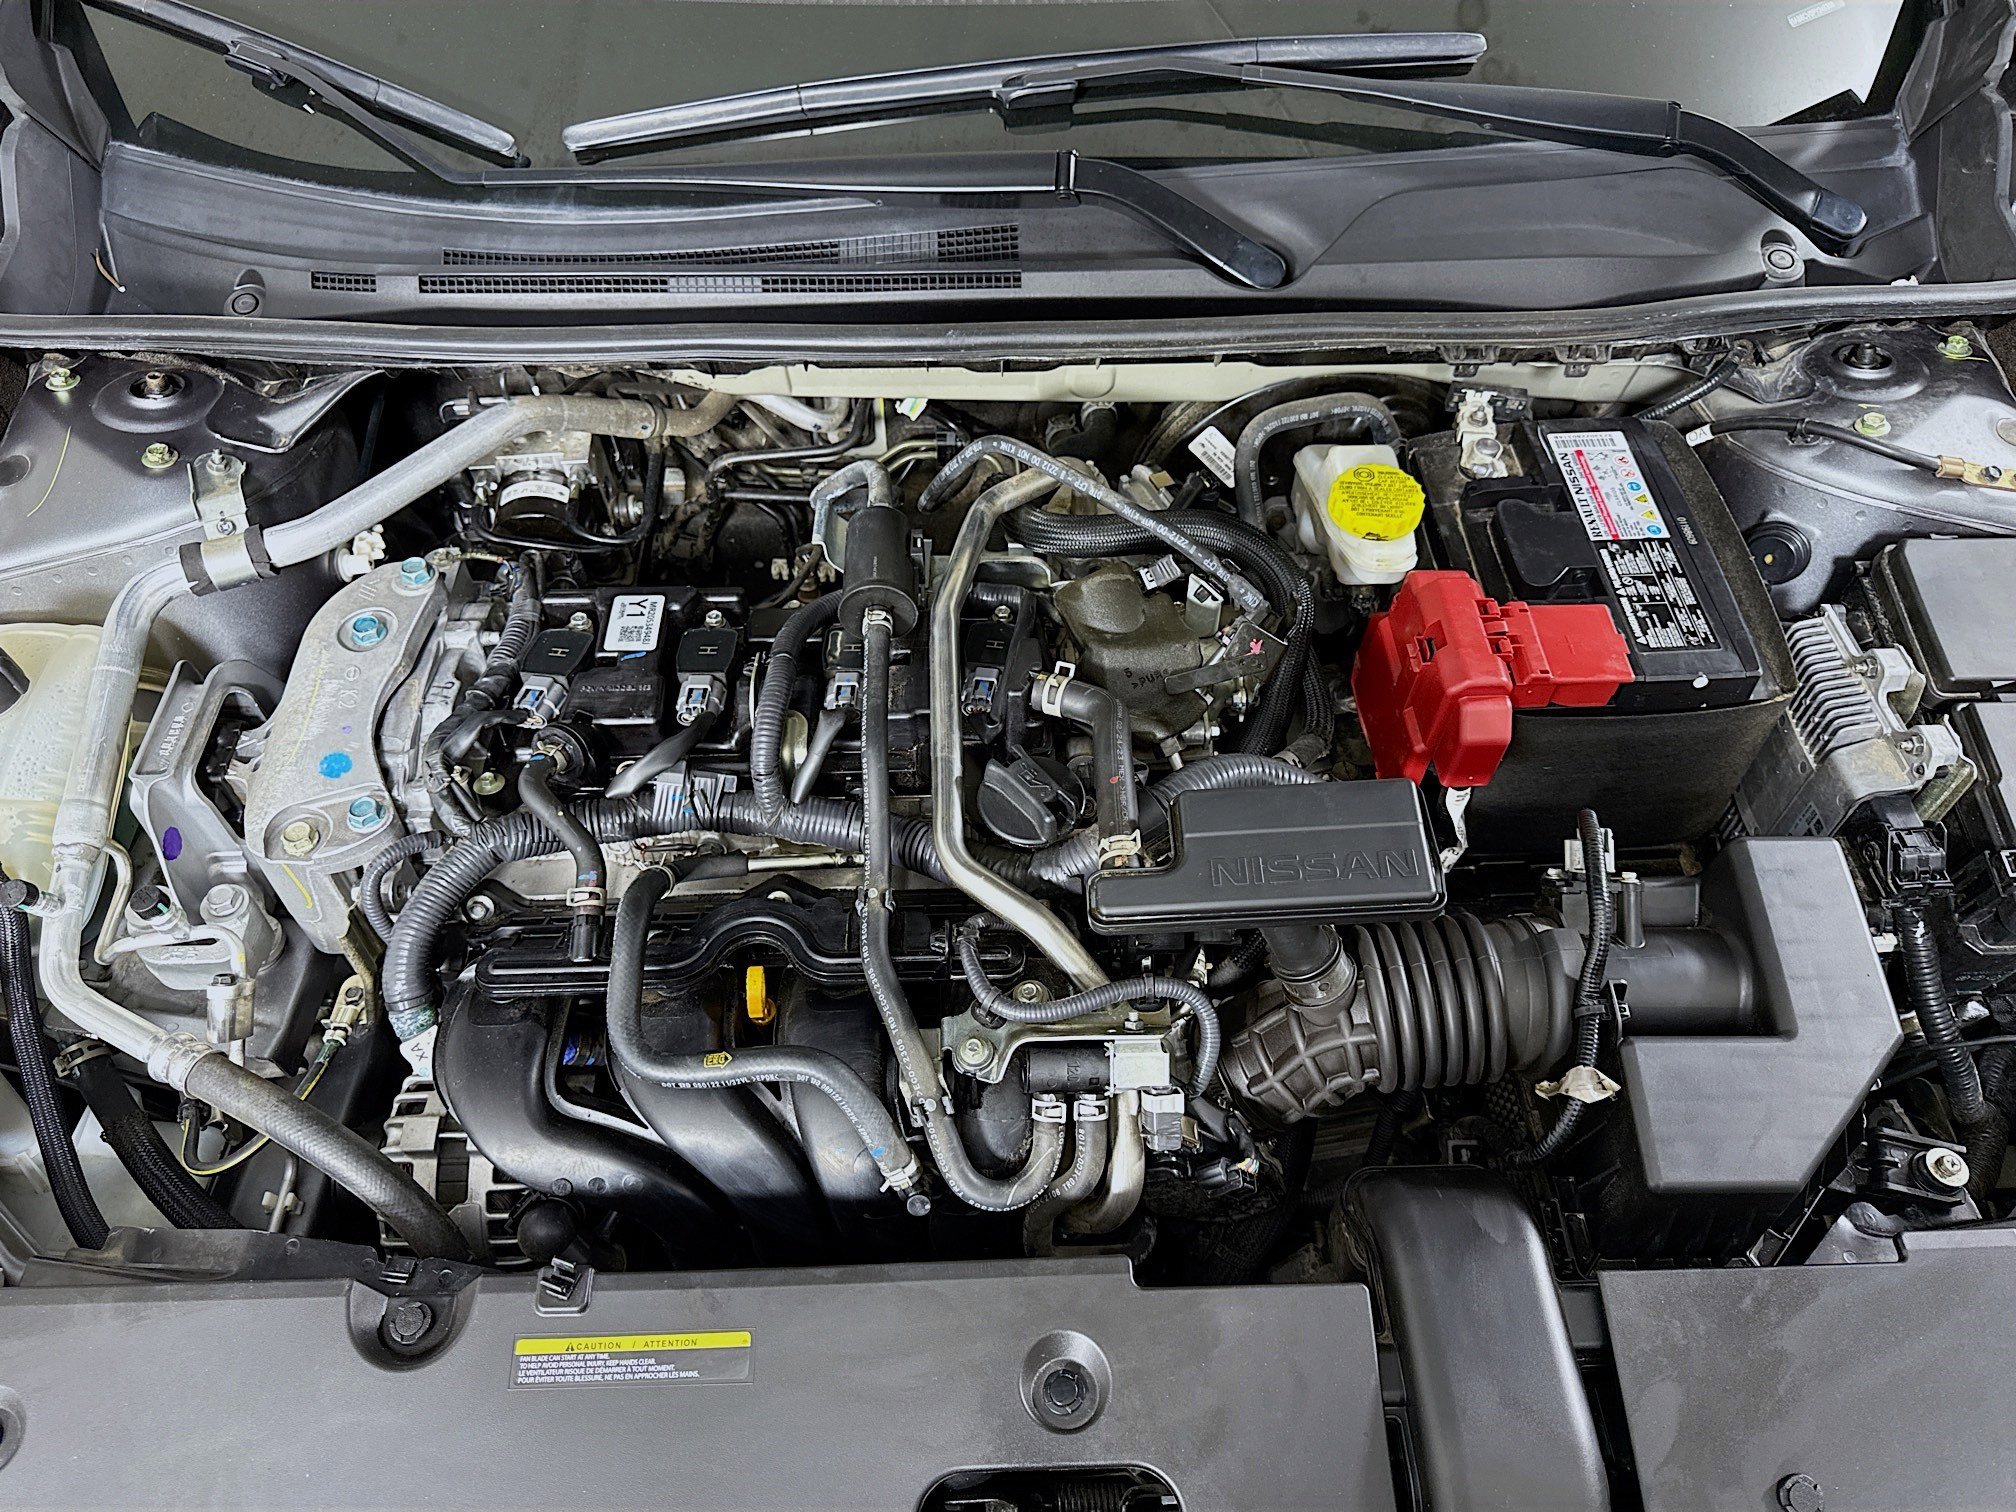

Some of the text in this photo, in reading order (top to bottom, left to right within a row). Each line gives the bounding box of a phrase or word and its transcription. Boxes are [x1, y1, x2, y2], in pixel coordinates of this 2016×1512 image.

[1000, 441, 1016, 455] KINK
[1017, 449, 1031, 462] NOT
[1031, 454, 1041, 465] DO
[1559, 452, 1584, 495] NISSAN
[1074, 477, 1089, 493] CFP
[1088, 487, 1104, 500] DTR
[1121, 504, 1140, 522] KINK
[1157, 522, 1170, 536] DO
[1203, 558, 1218, 571] CFP
[626, 598, 648, 616] Y1
[1243, 592, 1259, 609] KINK
[1210, 849, 1419, 887] NISSAN
[868, 968, 899, 1034] TRD>ECO<2305
[896, 1039, 926, 1105] D>ECO<2305
[926, 1122, 964, 1197] TRD>ECO<2305
[1062, 1128, 1086, 1192] TRD>ECO<2108
[576, 1342, 622, 1351] CAUTION
[643, 1338, 698, 1348] ATTENTION
[520, 1362, 528, 1370] TO
[560, 1360, 586, 1368] PERSONAL
[620, 1358, 638, 1366] HANDS
[532, 1354, 548, 1362] BLADE
[549, 1354, 560, 1362] CAN
[526, 1368, 564, 1376] VENTILATEUR
[565, 1368, 586, 1376] RISQUE
[595, 1366, 627, 1374] DÉMARRER
[648, 1364, 676, 1372] MOMENT.
[535, 1376, 555, 1384] ÉVITER
[625, 1372, 634, 1380] EN
[634, 1372, 669, 1380] APPROCHER
[680, 1370, 700, 1378] MAINS.
